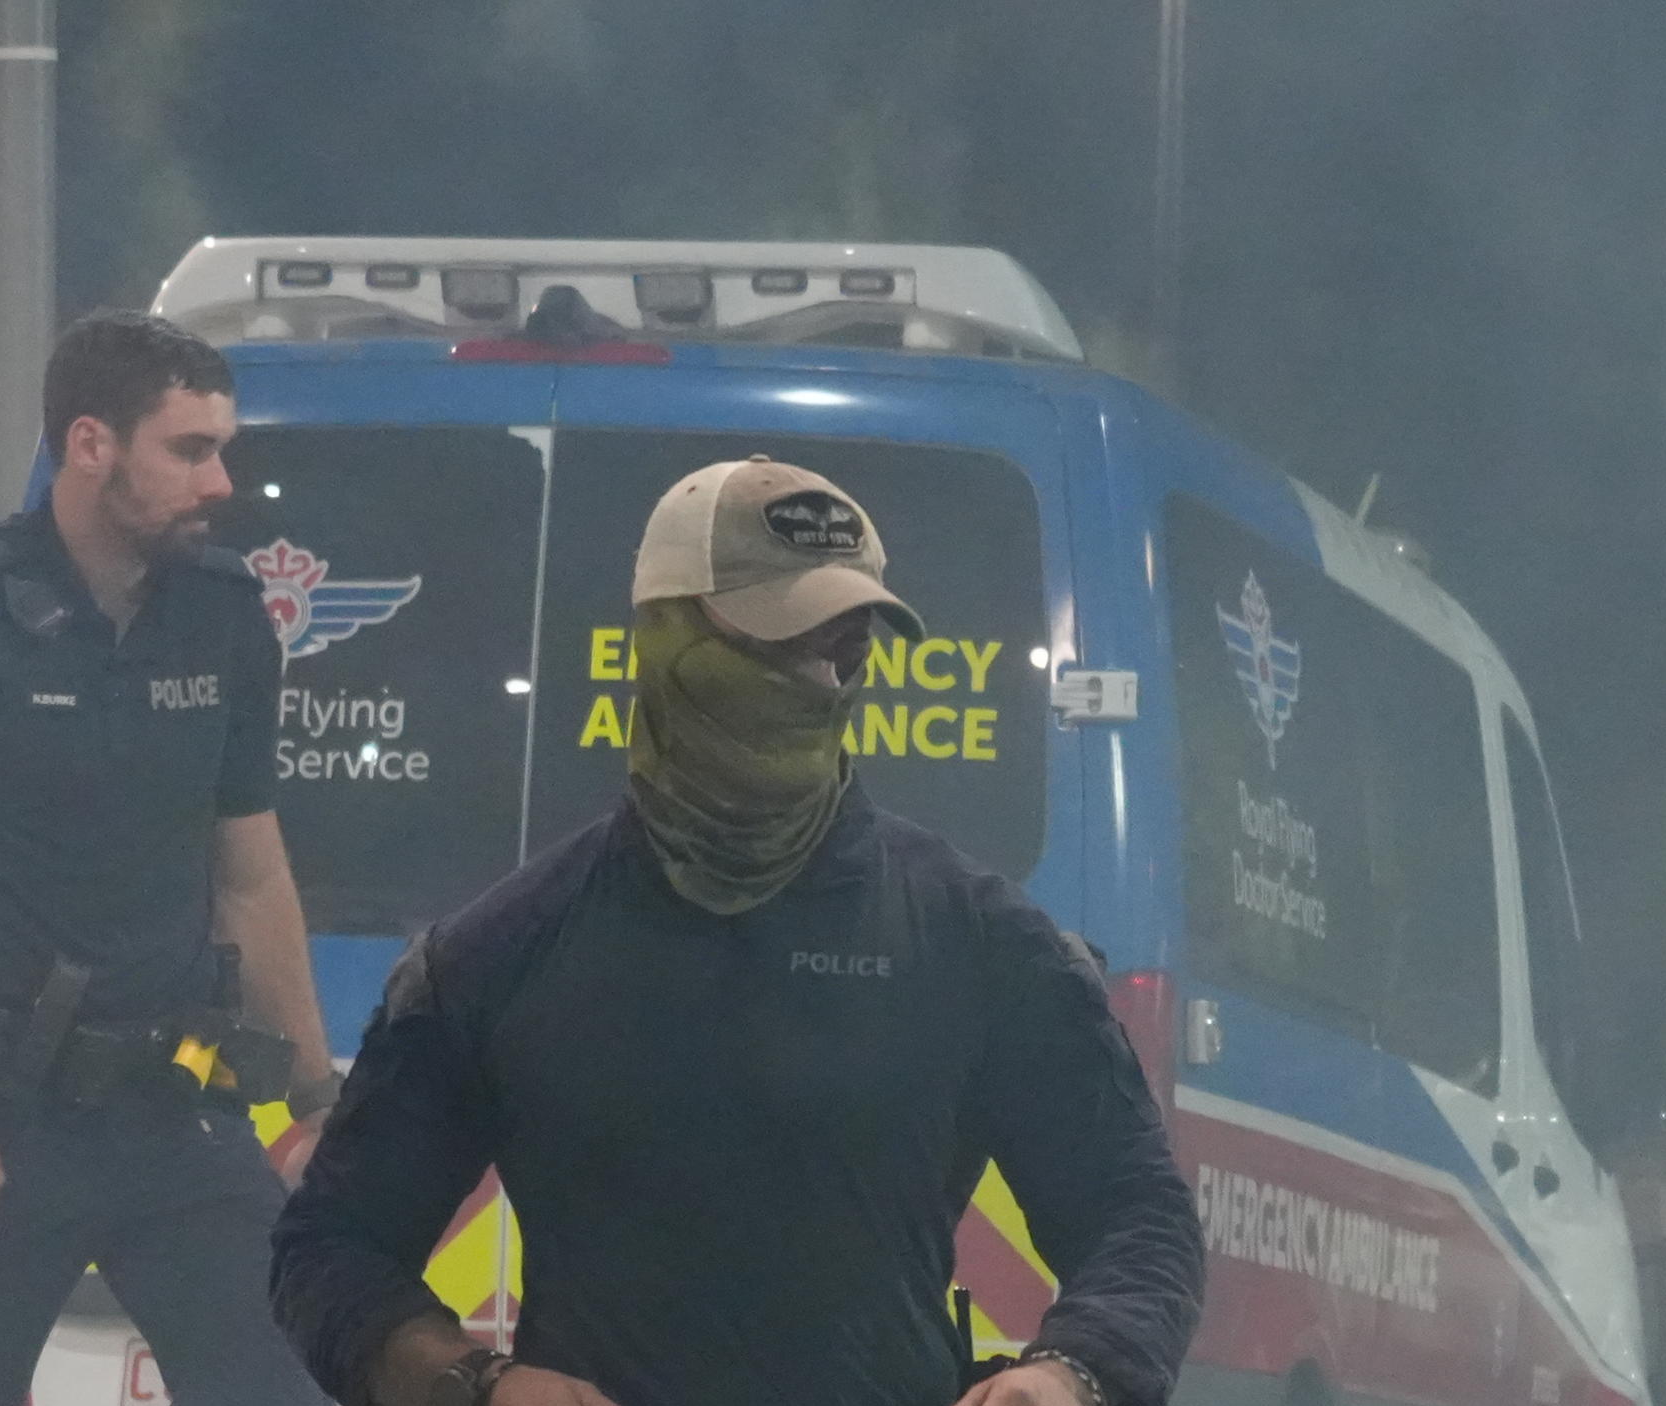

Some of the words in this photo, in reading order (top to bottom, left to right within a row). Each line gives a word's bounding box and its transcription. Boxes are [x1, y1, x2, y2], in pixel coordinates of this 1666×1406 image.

[150, 674, 221, 711] POLICE
[278, 687, 405, 739] Flying
[275, 740, 430, 780] Service
[790, 950, 893, 978] POLICE
[1197, 1162, 1330, 1284] EMERGENCY
[1328, 1205, 1440, 1314] AMBULANCE
